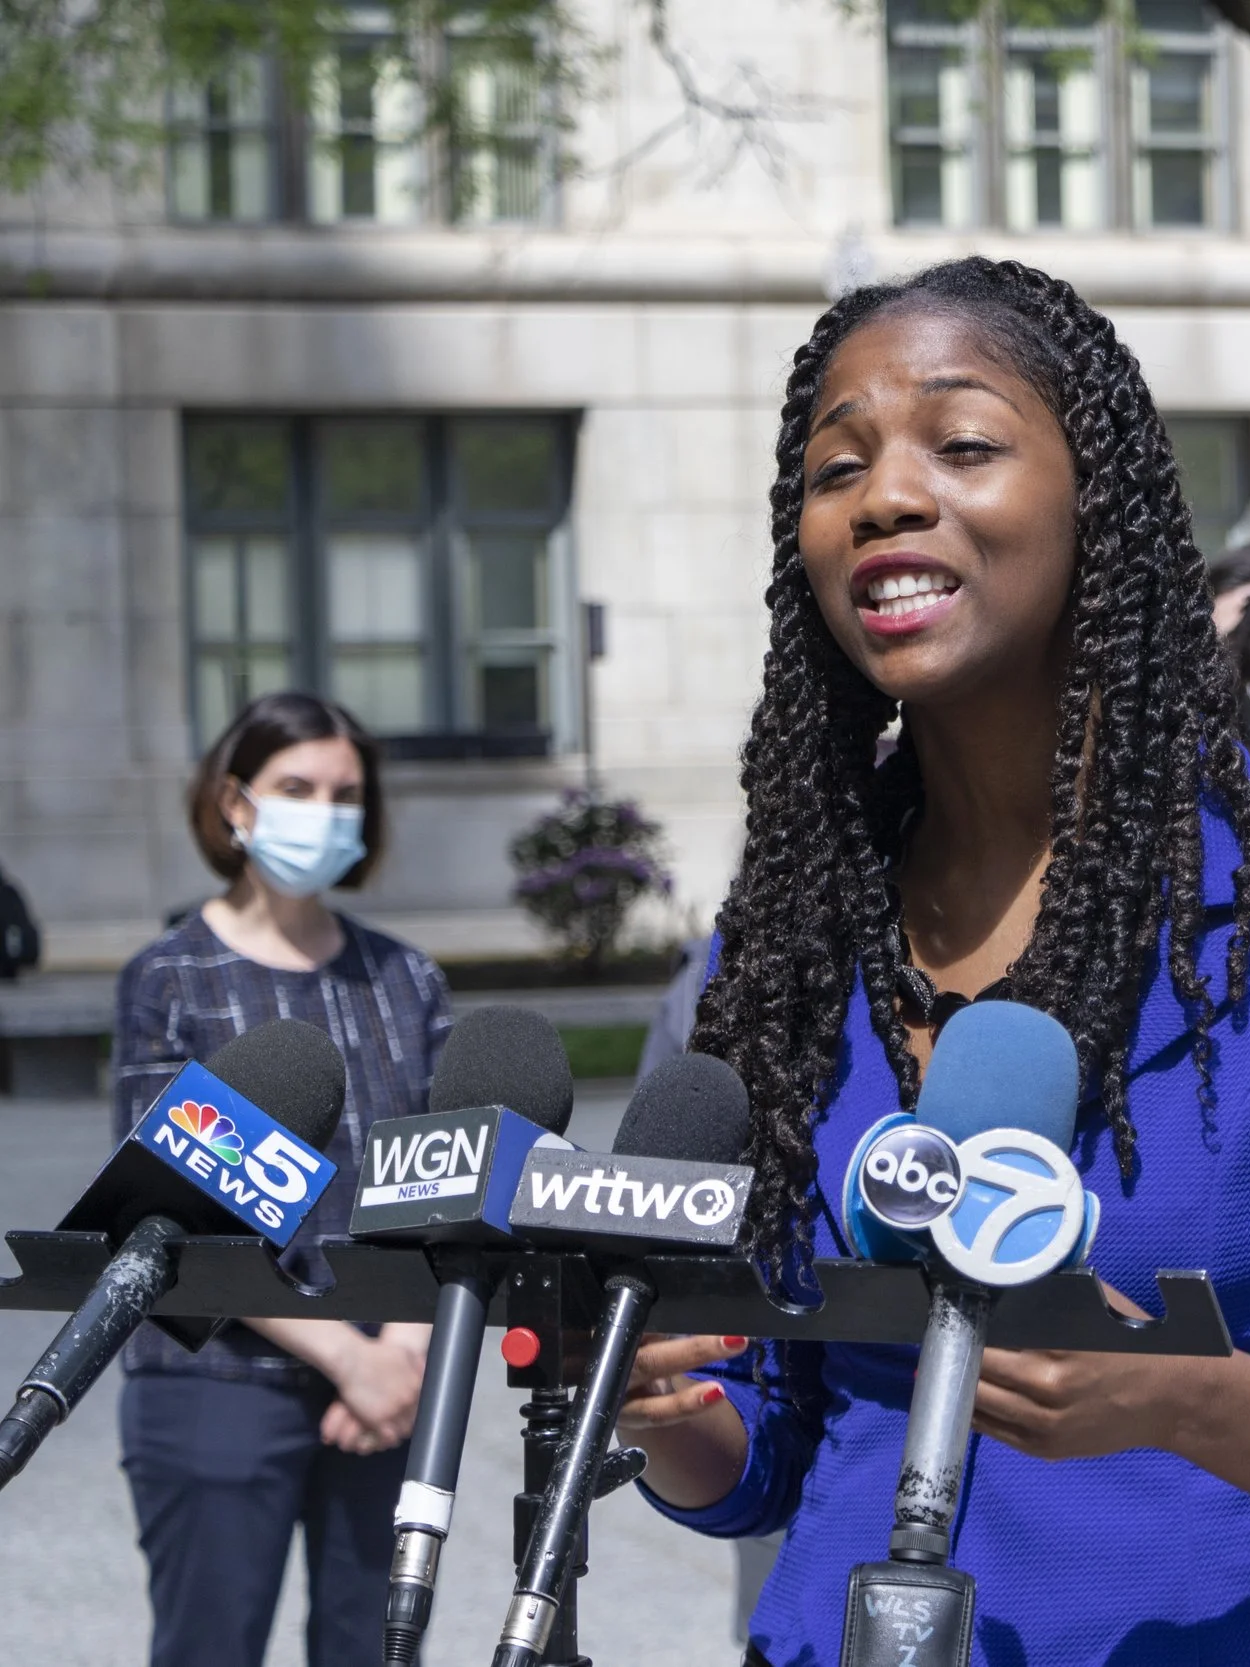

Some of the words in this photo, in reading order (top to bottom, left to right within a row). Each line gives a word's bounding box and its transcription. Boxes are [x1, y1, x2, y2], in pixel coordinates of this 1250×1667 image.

[153, 1123, 285, 1229] NEWS
[244, 1130, 321, 1204] 5
[373, 1125, 488, 1186] WGN
[397, 1182, 440, 1200] NEWS
[531, 1168, 685, 1220] wttw
[866, 1148, 958, 1204] abc
[938, 1134, 1080, 1280] 7
[865, 1594, 931, 1624] WLS
[892, 1623, 934, 1642] TV
